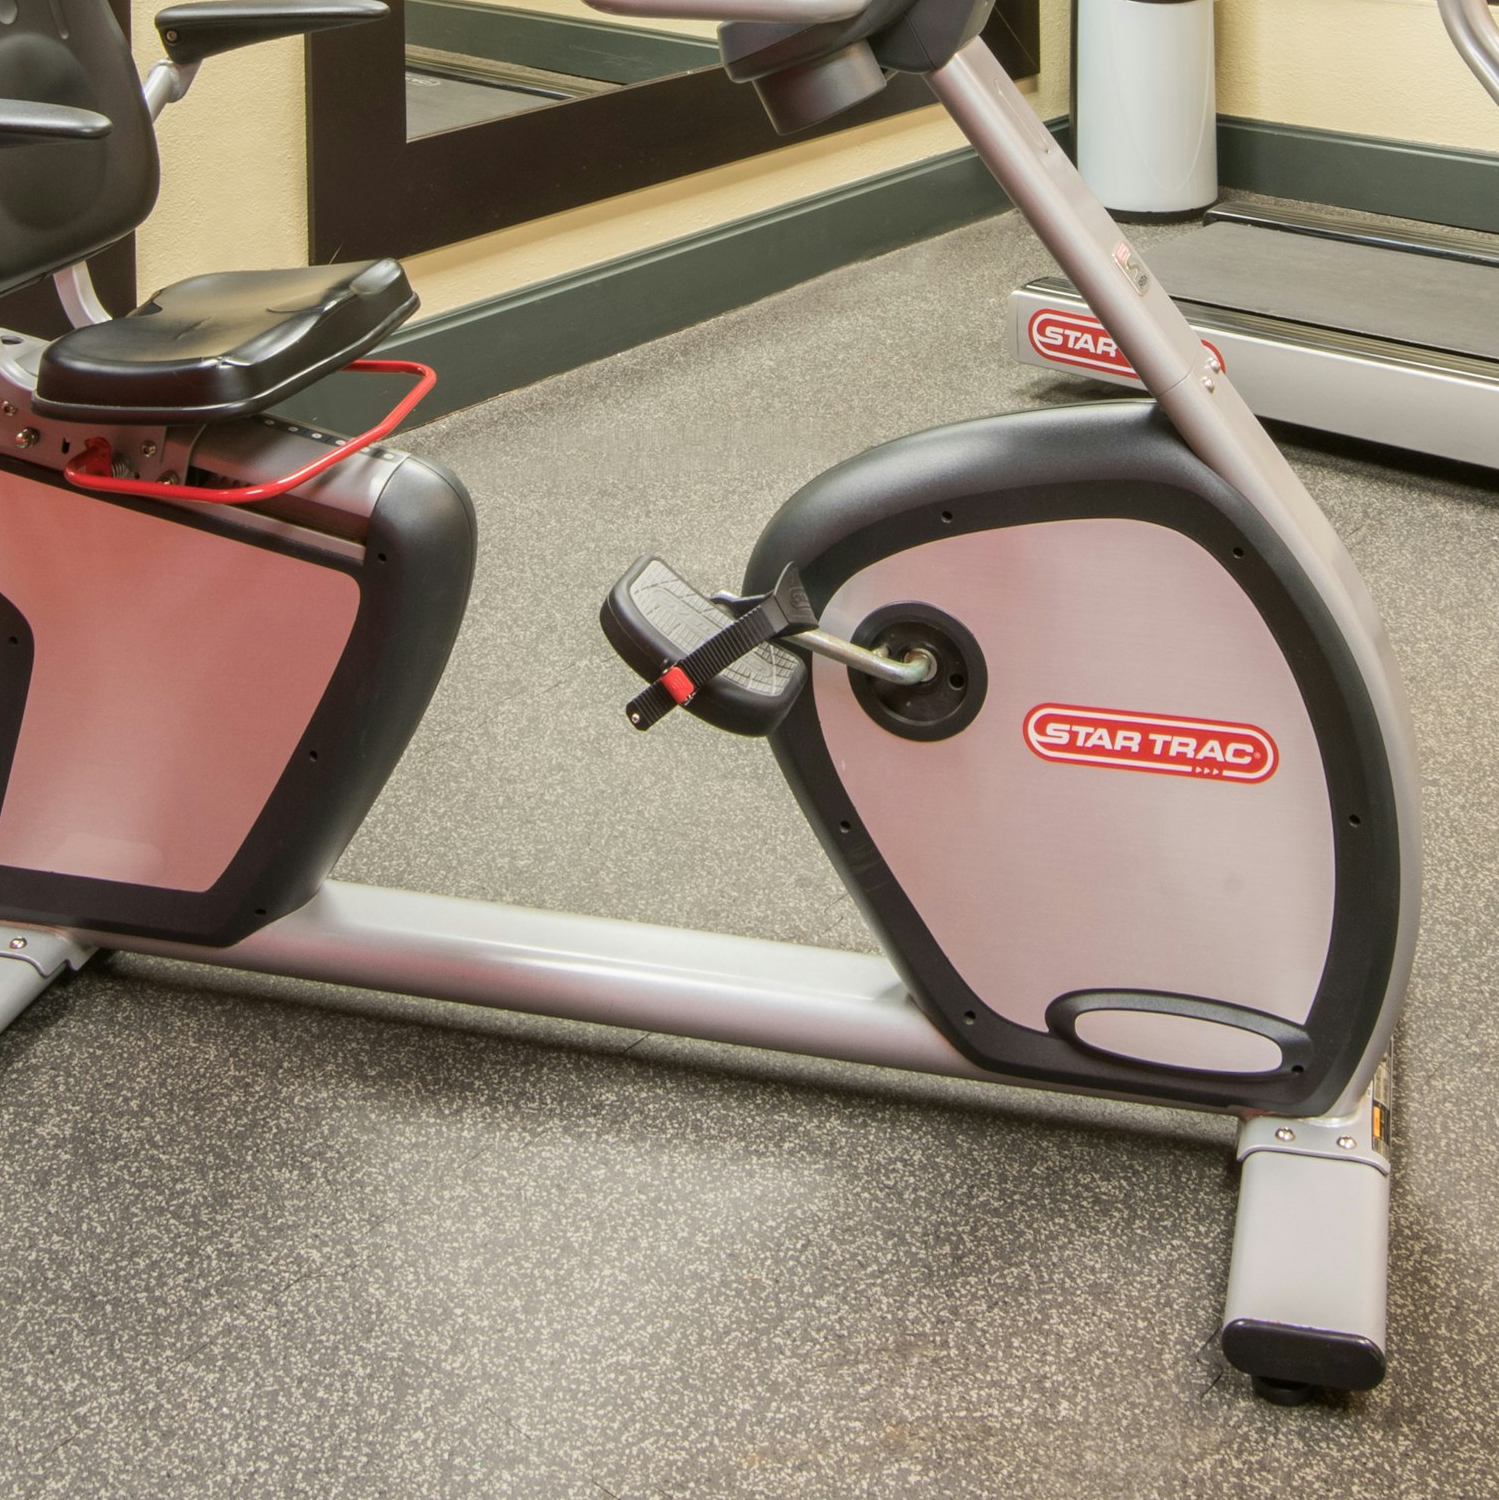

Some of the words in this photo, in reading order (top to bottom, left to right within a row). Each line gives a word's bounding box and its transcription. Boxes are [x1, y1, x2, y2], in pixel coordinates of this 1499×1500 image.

[1042, 326, 1119, 358] STAR
[1044, 722, 1142, 752] STAR
[1148, 733, 1255, 765] TRAC
